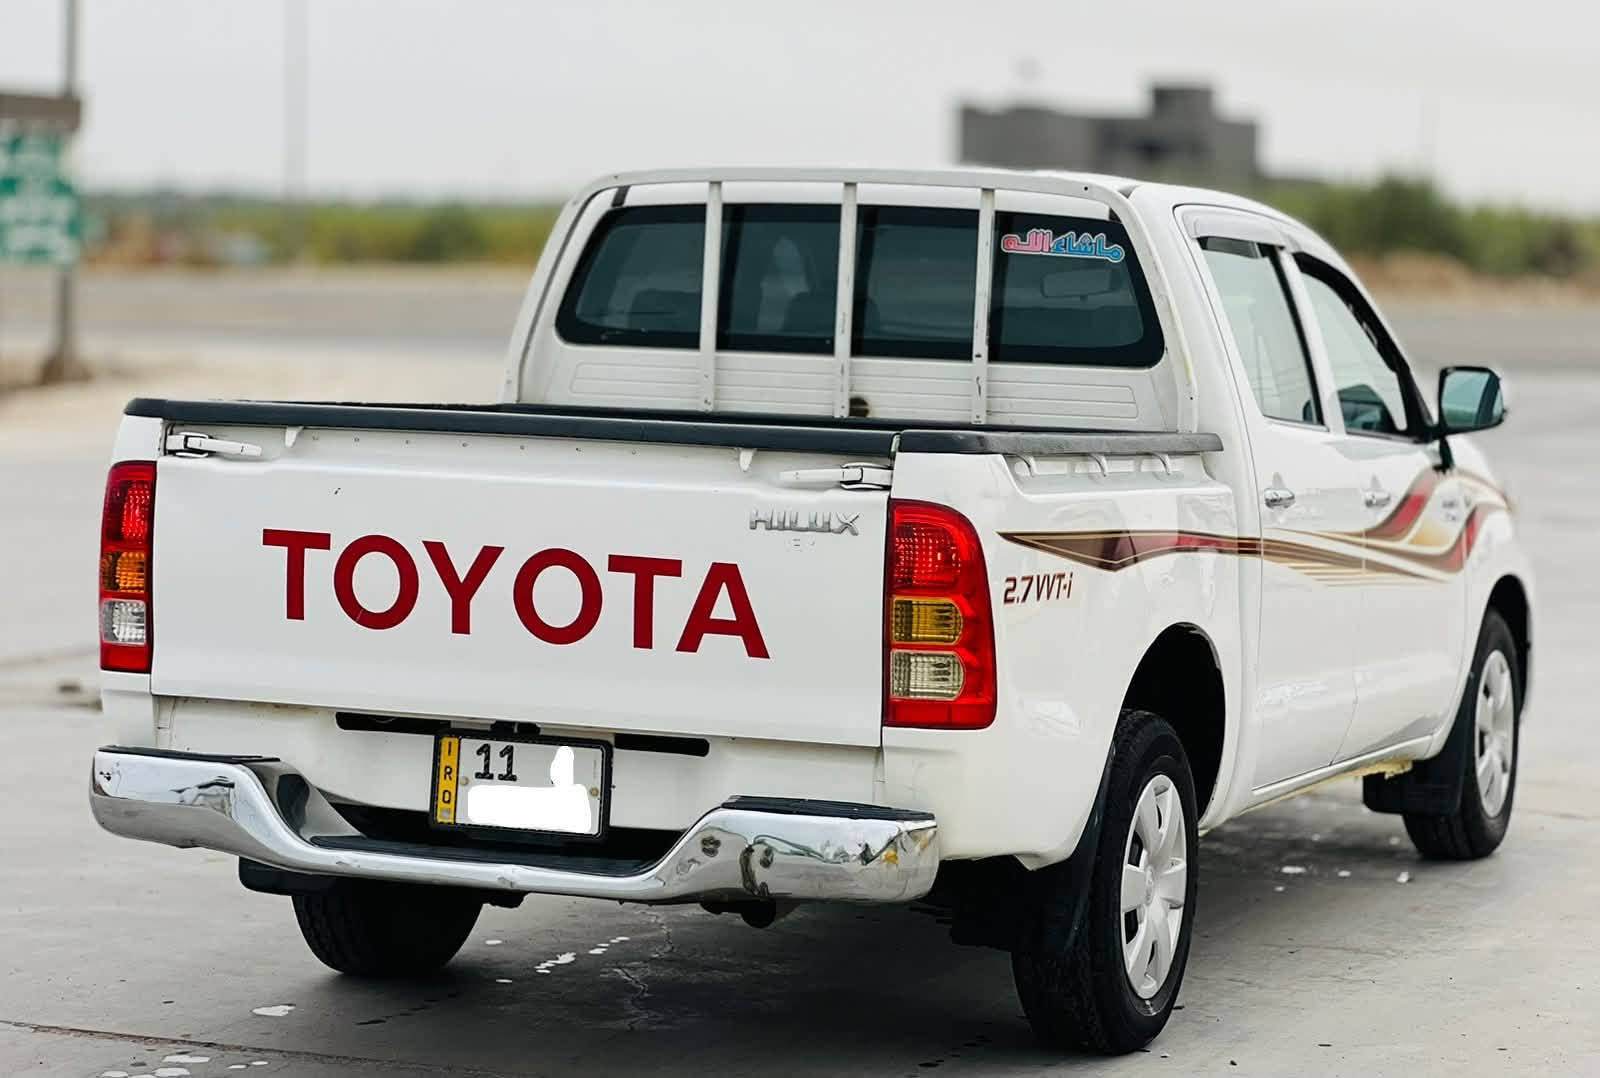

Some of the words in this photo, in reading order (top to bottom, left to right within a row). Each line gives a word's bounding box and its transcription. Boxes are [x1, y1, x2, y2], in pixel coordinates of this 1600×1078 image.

[1003, 229, 1051, 253] الله
[750, 508, 860, 536] HILUX
[262, 528, 771, 659] TOYOTA
[474, 743, 517, 782] 11
